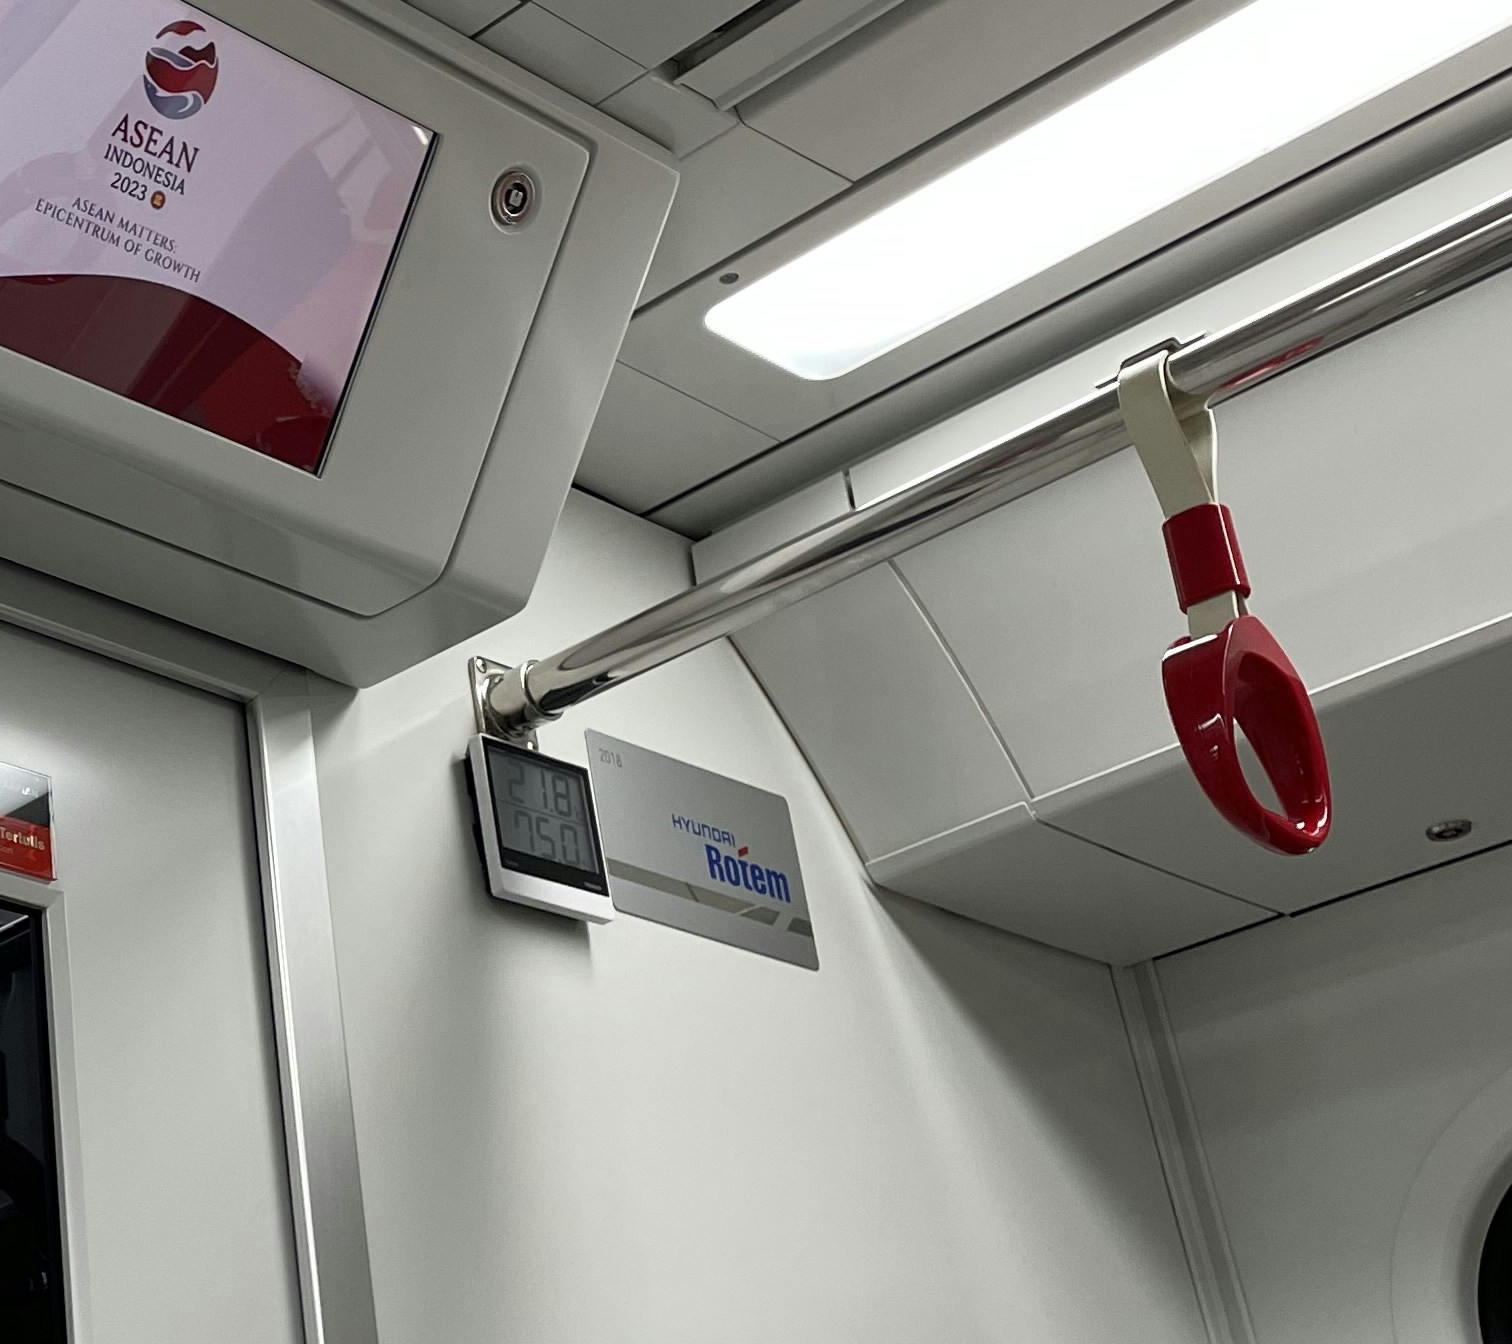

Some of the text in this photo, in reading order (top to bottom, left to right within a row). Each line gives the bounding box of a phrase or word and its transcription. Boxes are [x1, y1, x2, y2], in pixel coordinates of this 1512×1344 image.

[104, 143, 185, 195] INDONESIA
[111, 113, 200, 173] ASEAN
[72, 197, 115, 224] ASEAN
[110, 172, 148, 201] 2023
[35, 197, 201, 283] EPICENTRUM OF GROWTH
[672, 813, 736, 848] HYUNDAI
[704, 843, 791, 904] Rotem
